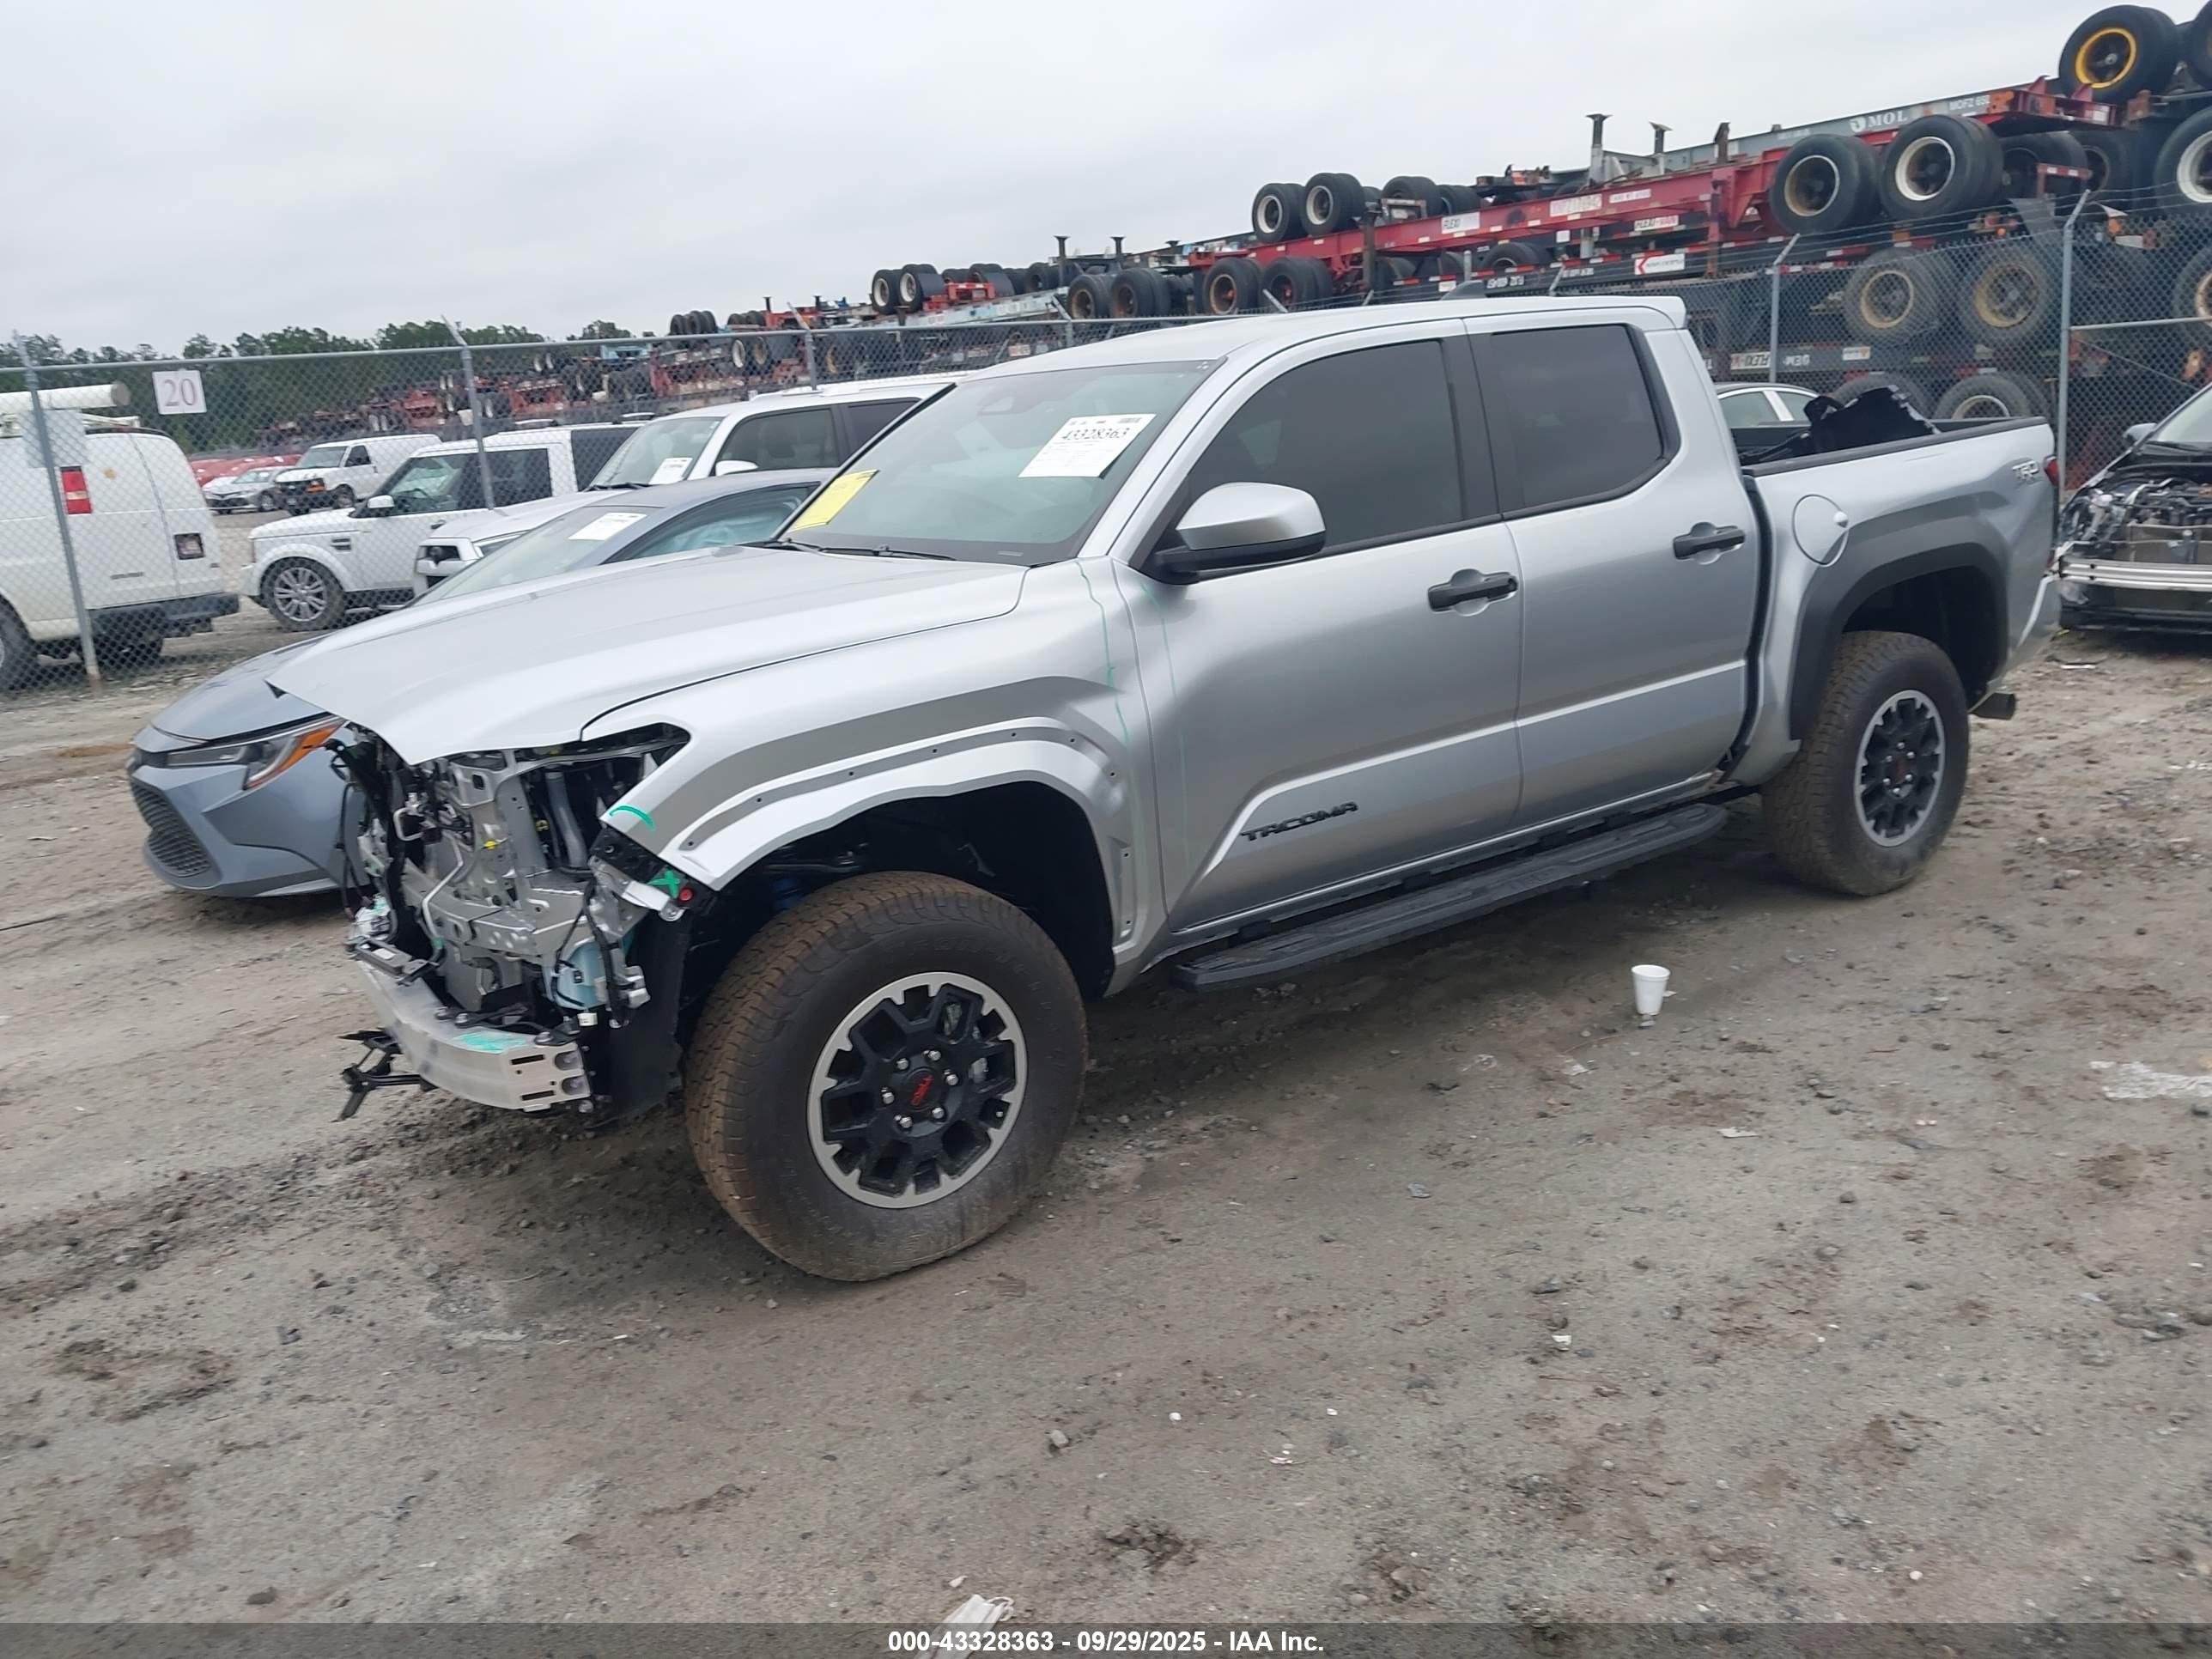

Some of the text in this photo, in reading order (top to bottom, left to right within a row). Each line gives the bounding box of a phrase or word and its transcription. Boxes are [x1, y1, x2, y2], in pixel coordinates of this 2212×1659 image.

[1868, 110, 1908, 127] MOL
[163, 378, 198, 407] 20
[1240, 801, 1358, 841] TACOMA
